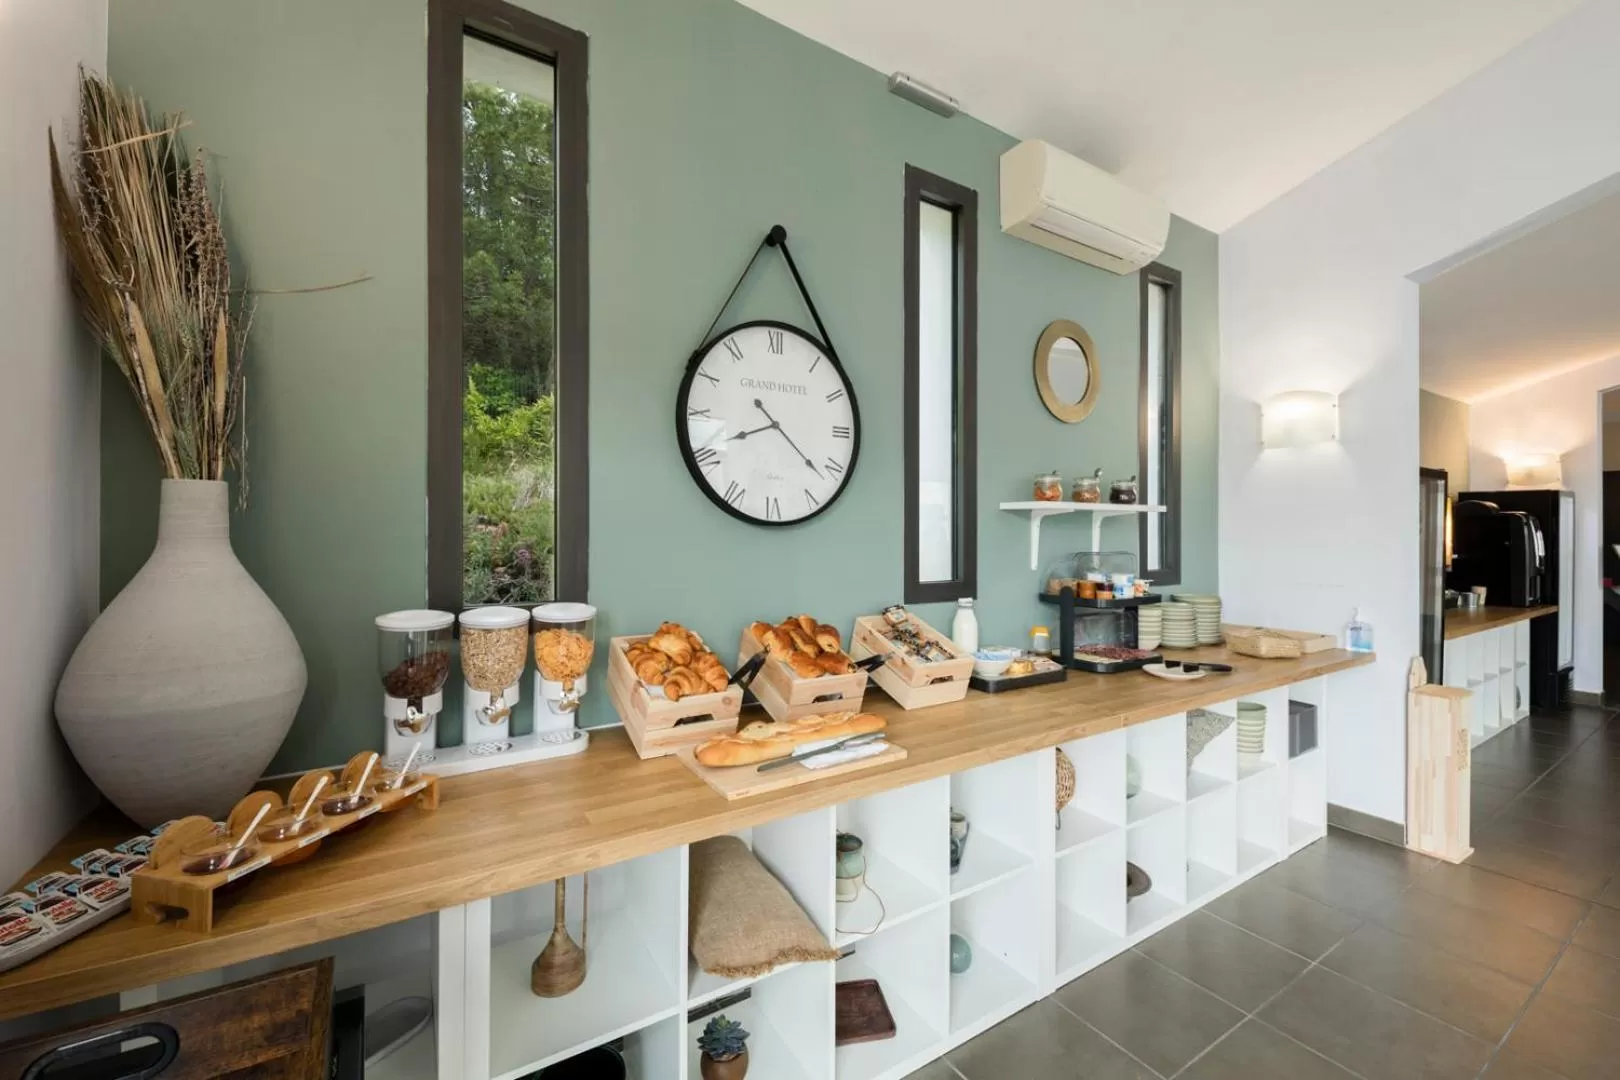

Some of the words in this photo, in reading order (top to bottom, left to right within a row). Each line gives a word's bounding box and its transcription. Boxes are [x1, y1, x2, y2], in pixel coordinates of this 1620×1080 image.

[723, 336, 744, 363] XI
[768, 329, 783, 355] XII
[740, 377, 777, 391] GRAND
[777, 383, 808, 396] HOTEL
[832, 425, 850, 439] III
[766, 496, 782, 520] VI
